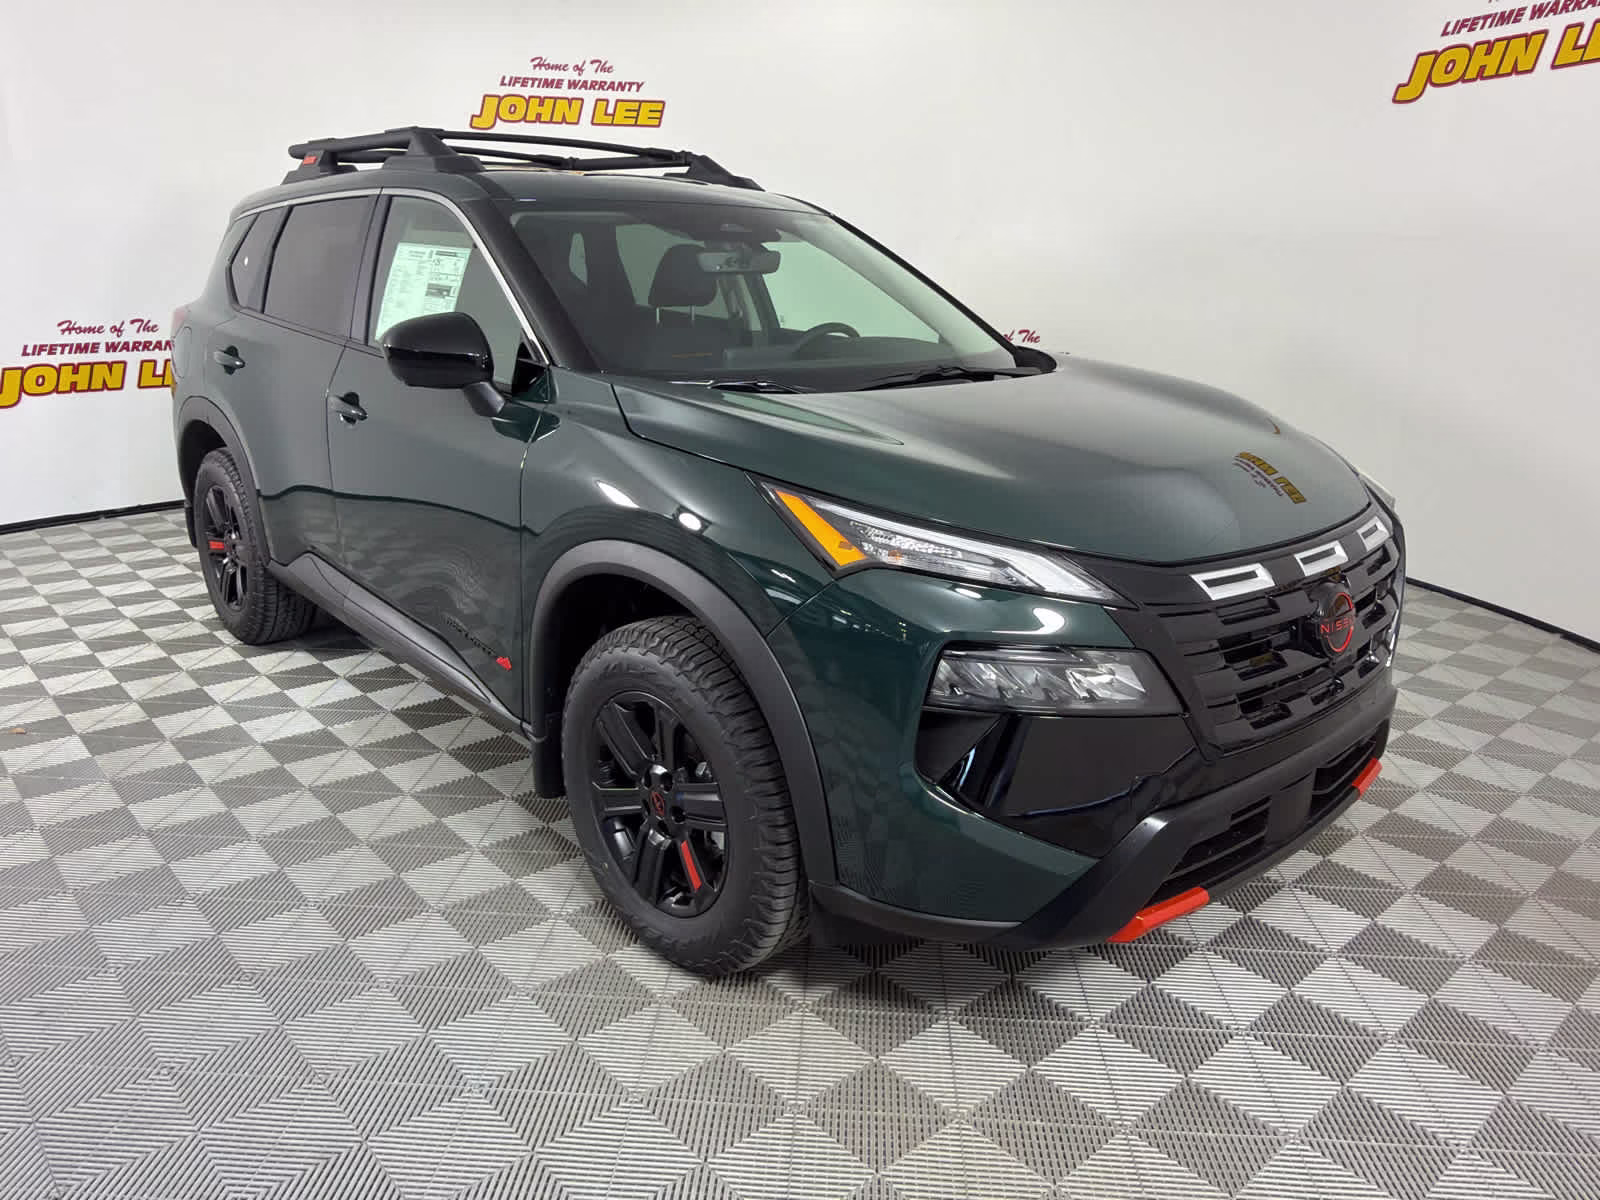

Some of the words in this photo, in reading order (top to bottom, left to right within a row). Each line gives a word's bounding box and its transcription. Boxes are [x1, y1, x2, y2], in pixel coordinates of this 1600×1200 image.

[1440, 6, 1528, 37] LIFETIME
[1529, 0, 1600, 20] WARRA
[530, 57, 569, 72] Home
[573, 60, 586, 75] of
[590, 59, 614, 74] The
[1392, 29, 1549, 104] JOHN
[499, 75, 564, 90] LIFETIME
[567, 79, 644, 92] WARRANTY
[470, 94, 584, 130] JOHN
[591, 98, 666, 128] LEE
[57, 319, 105, 335] Home
[110, 320, 125, 338] of
[130, 318, 159, 334] The
[1018, 329, 1040, 343] The
[21, 342, 100, 357] LIFETIME
[105, 339, 172, 353] WARRAN
[0, 360, 127, 409] JOHN
